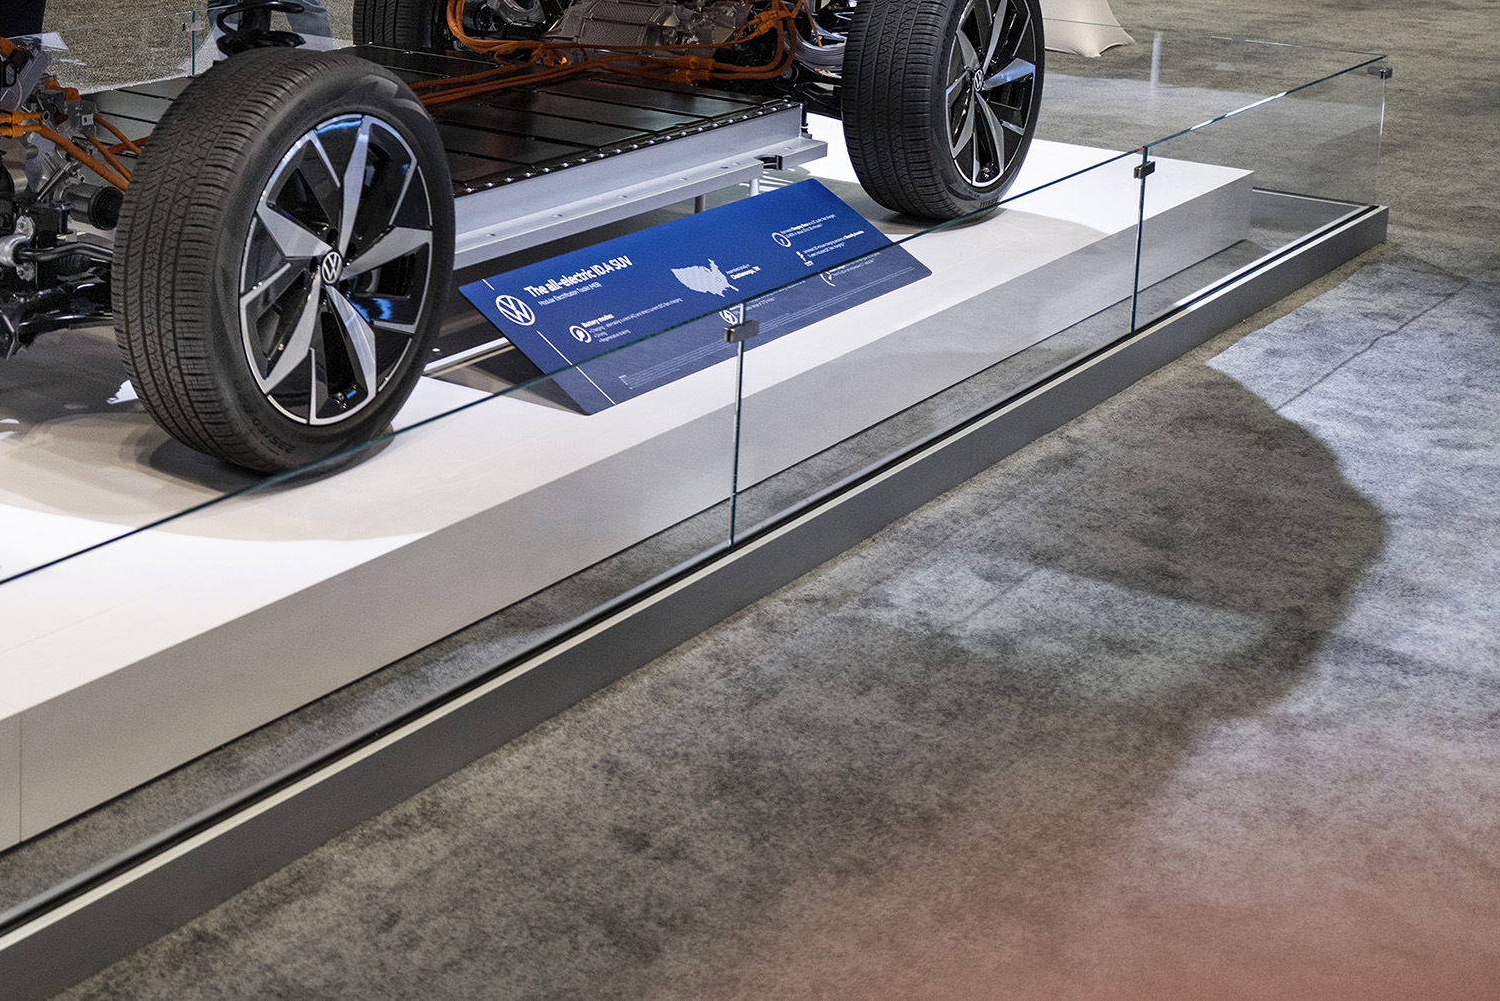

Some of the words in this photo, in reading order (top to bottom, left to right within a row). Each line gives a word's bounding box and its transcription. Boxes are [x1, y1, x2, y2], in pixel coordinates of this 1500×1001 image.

[522, 285, 549, 297] The
[544, 268, 597, 292] all-electric
[589, 261, 615, 276] ID.4
[608, 254, 633, 270] SUV
[580, 318, 600, 328] Battery
